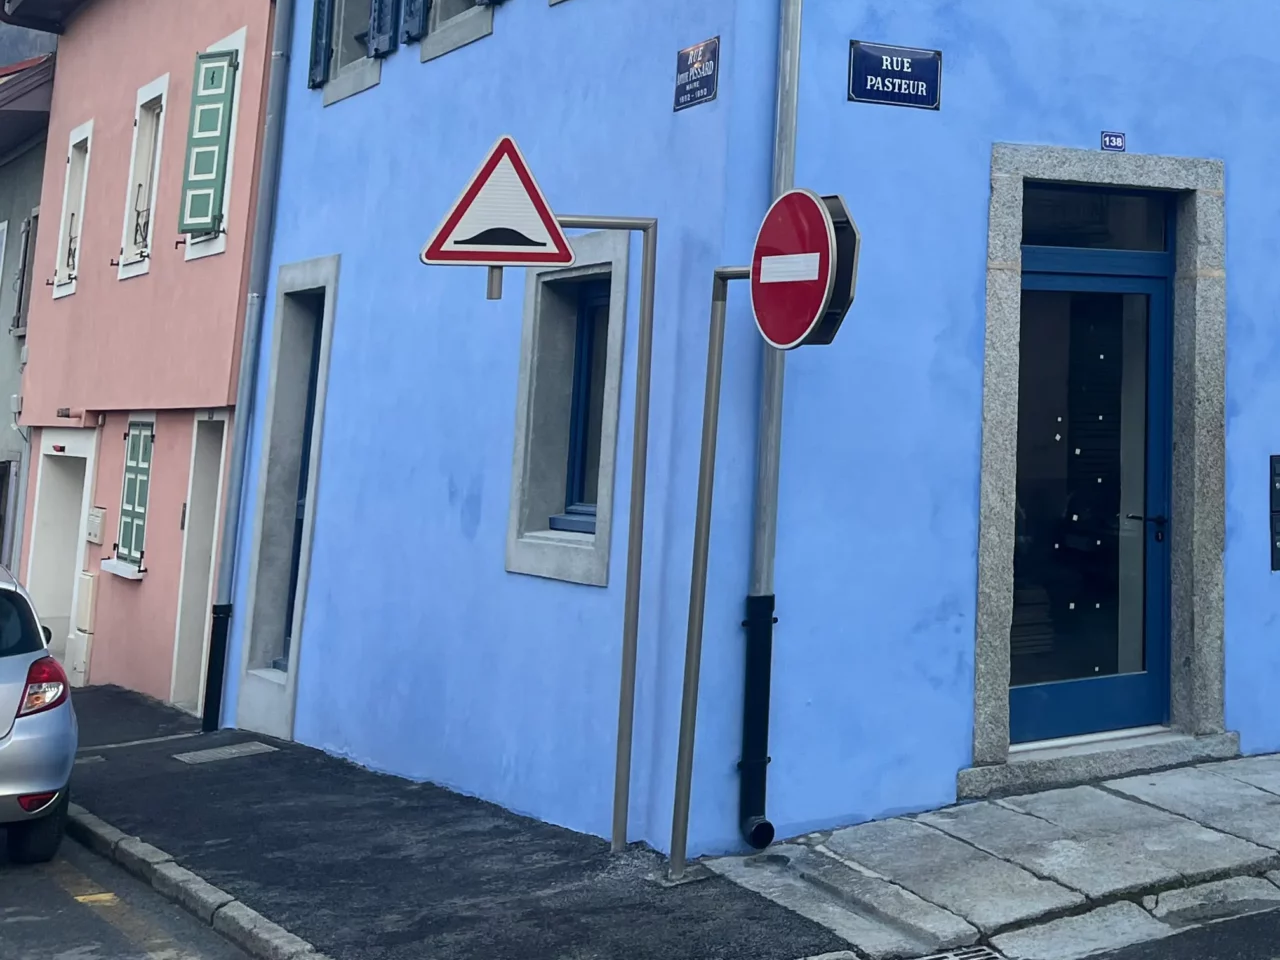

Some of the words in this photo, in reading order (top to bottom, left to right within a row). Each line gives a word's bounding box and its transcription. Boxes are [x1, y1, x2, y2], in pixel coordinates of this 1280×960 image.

[688, 46, 704, 65] RUE
[881, 55, 912, 72] RUE
[865, 75, 927, 96] PASTEUR
[1104, 136, 1123, 147] 138
